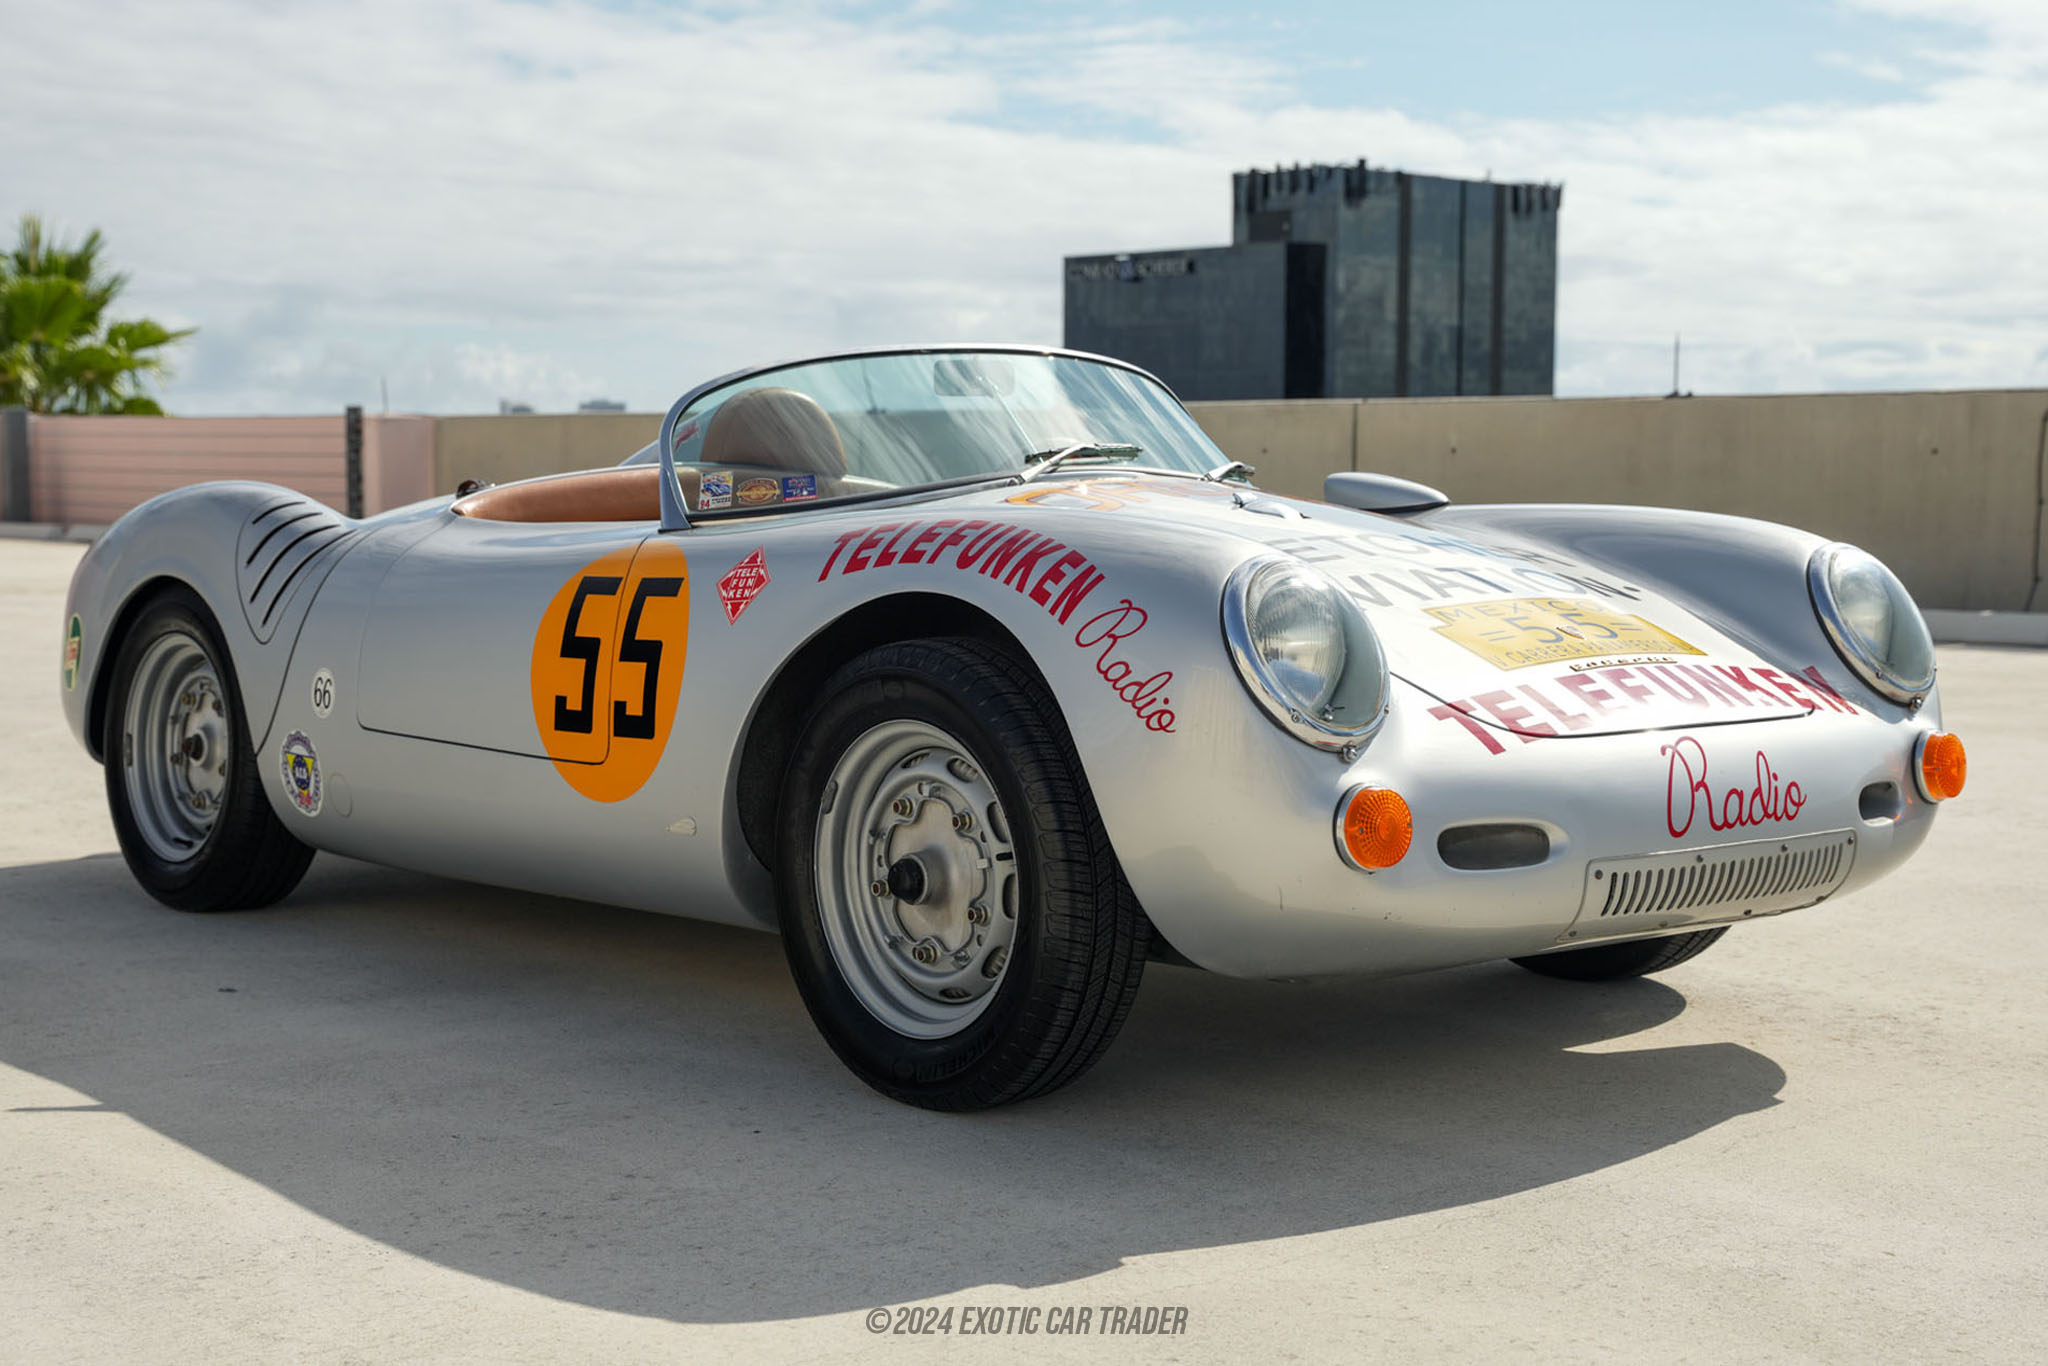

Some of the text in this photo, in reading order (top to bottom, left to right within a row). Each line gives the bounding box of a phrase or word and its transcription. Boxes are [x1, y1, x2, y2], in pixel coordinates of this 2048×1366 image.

[732, 578, 755, 588] FUN
[736, 567, 759, 577] TELE
[1349, 567, 1641, 608] VIATION.
[728, 588, 752, 599] KEN
[1434, 600, 1605, 622] MEXICO
[818, 519, 1176, 733] TELEFUNKEN Radio
[554, 576, 685, 740] 55
[314, 677, 332, 709] 66
[1427, 665, 1859, 755] TELEFUNKEN
[1661, 736, 1807, 838] Radio
